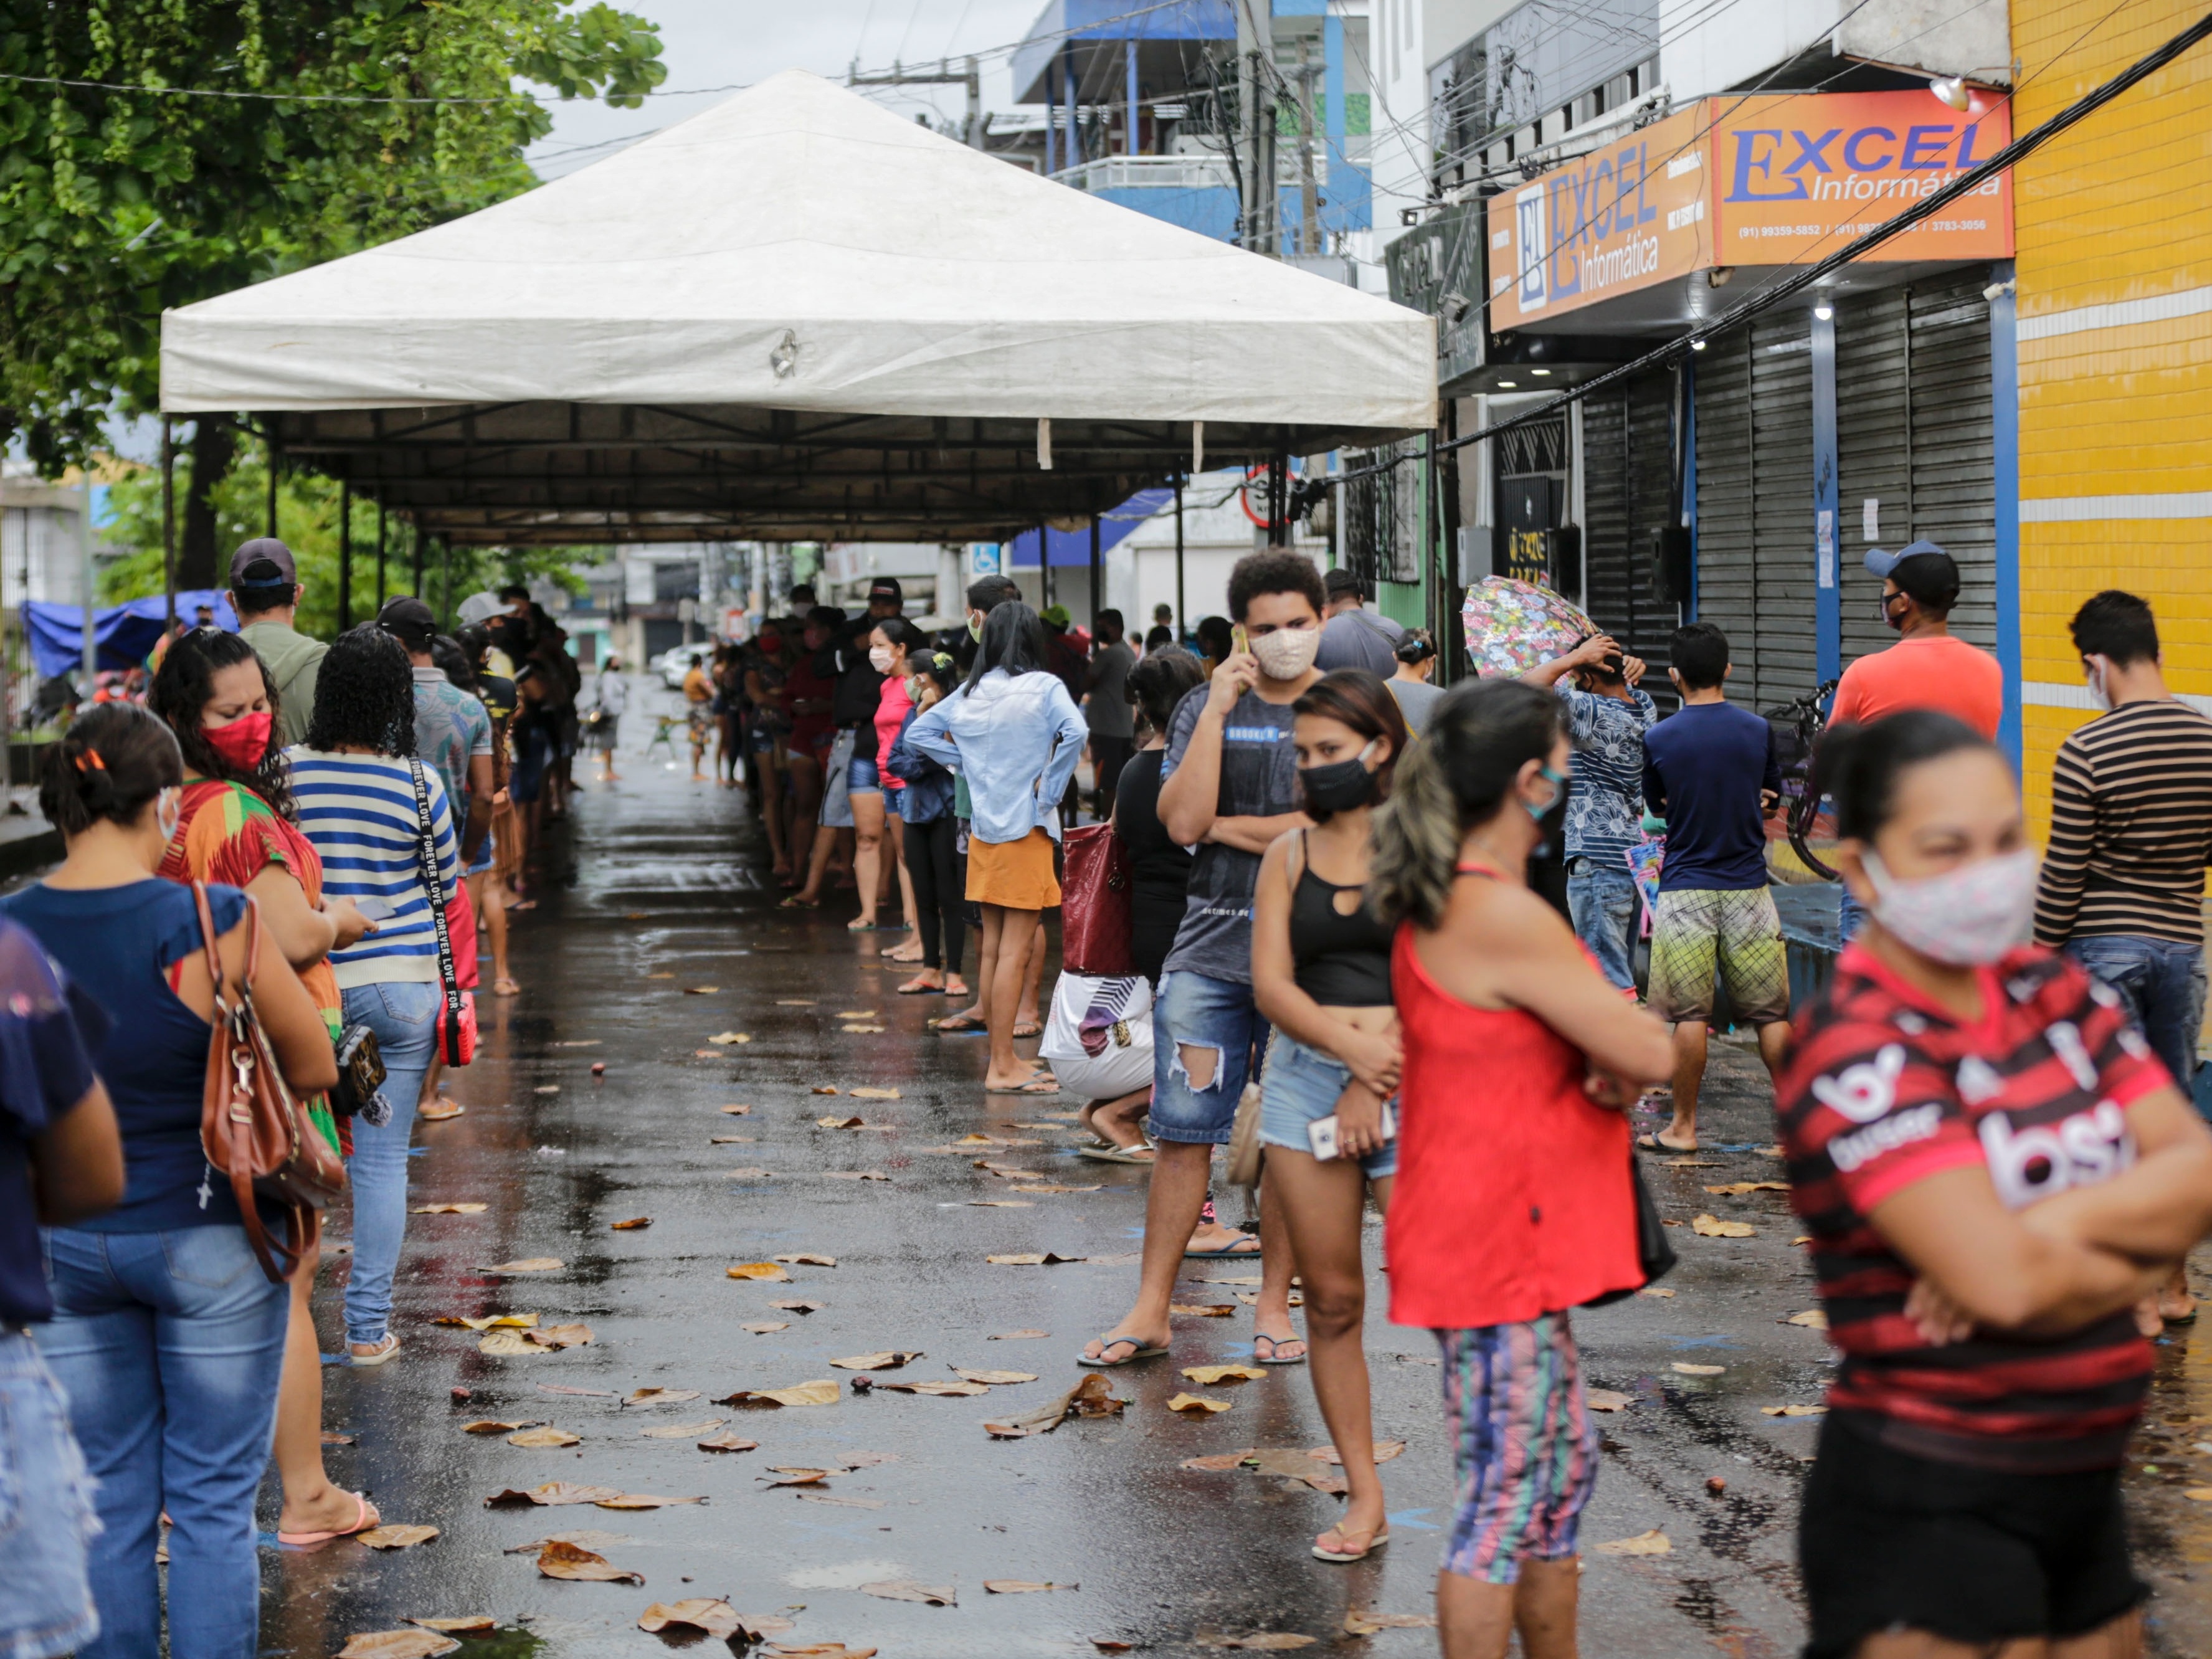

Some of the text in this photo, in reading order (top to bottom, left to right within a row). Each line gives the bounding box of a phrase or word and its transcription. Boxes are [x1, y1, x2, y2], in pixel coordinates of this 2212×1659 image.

[1724, 123, 1986, 202] EXCEL
[1549, 141, 1657, 302] EXCEL
[1739, 226, 1759, 239] (91)
[1761, 224, 1821, 237] 99359-5852
[1835, 222, 1856, 237] (91)
[1932, 220, 1986, 231] 3783-3056
[1580, 229, 1659, 293] Informática
[411, 761, 431, 827] FOREVER LOVE
[423, 834, 442, 906] FOREVER LOVE
[435, 911, 451, 955] FOREVER
[442, 958, 455, 983] LOVE
